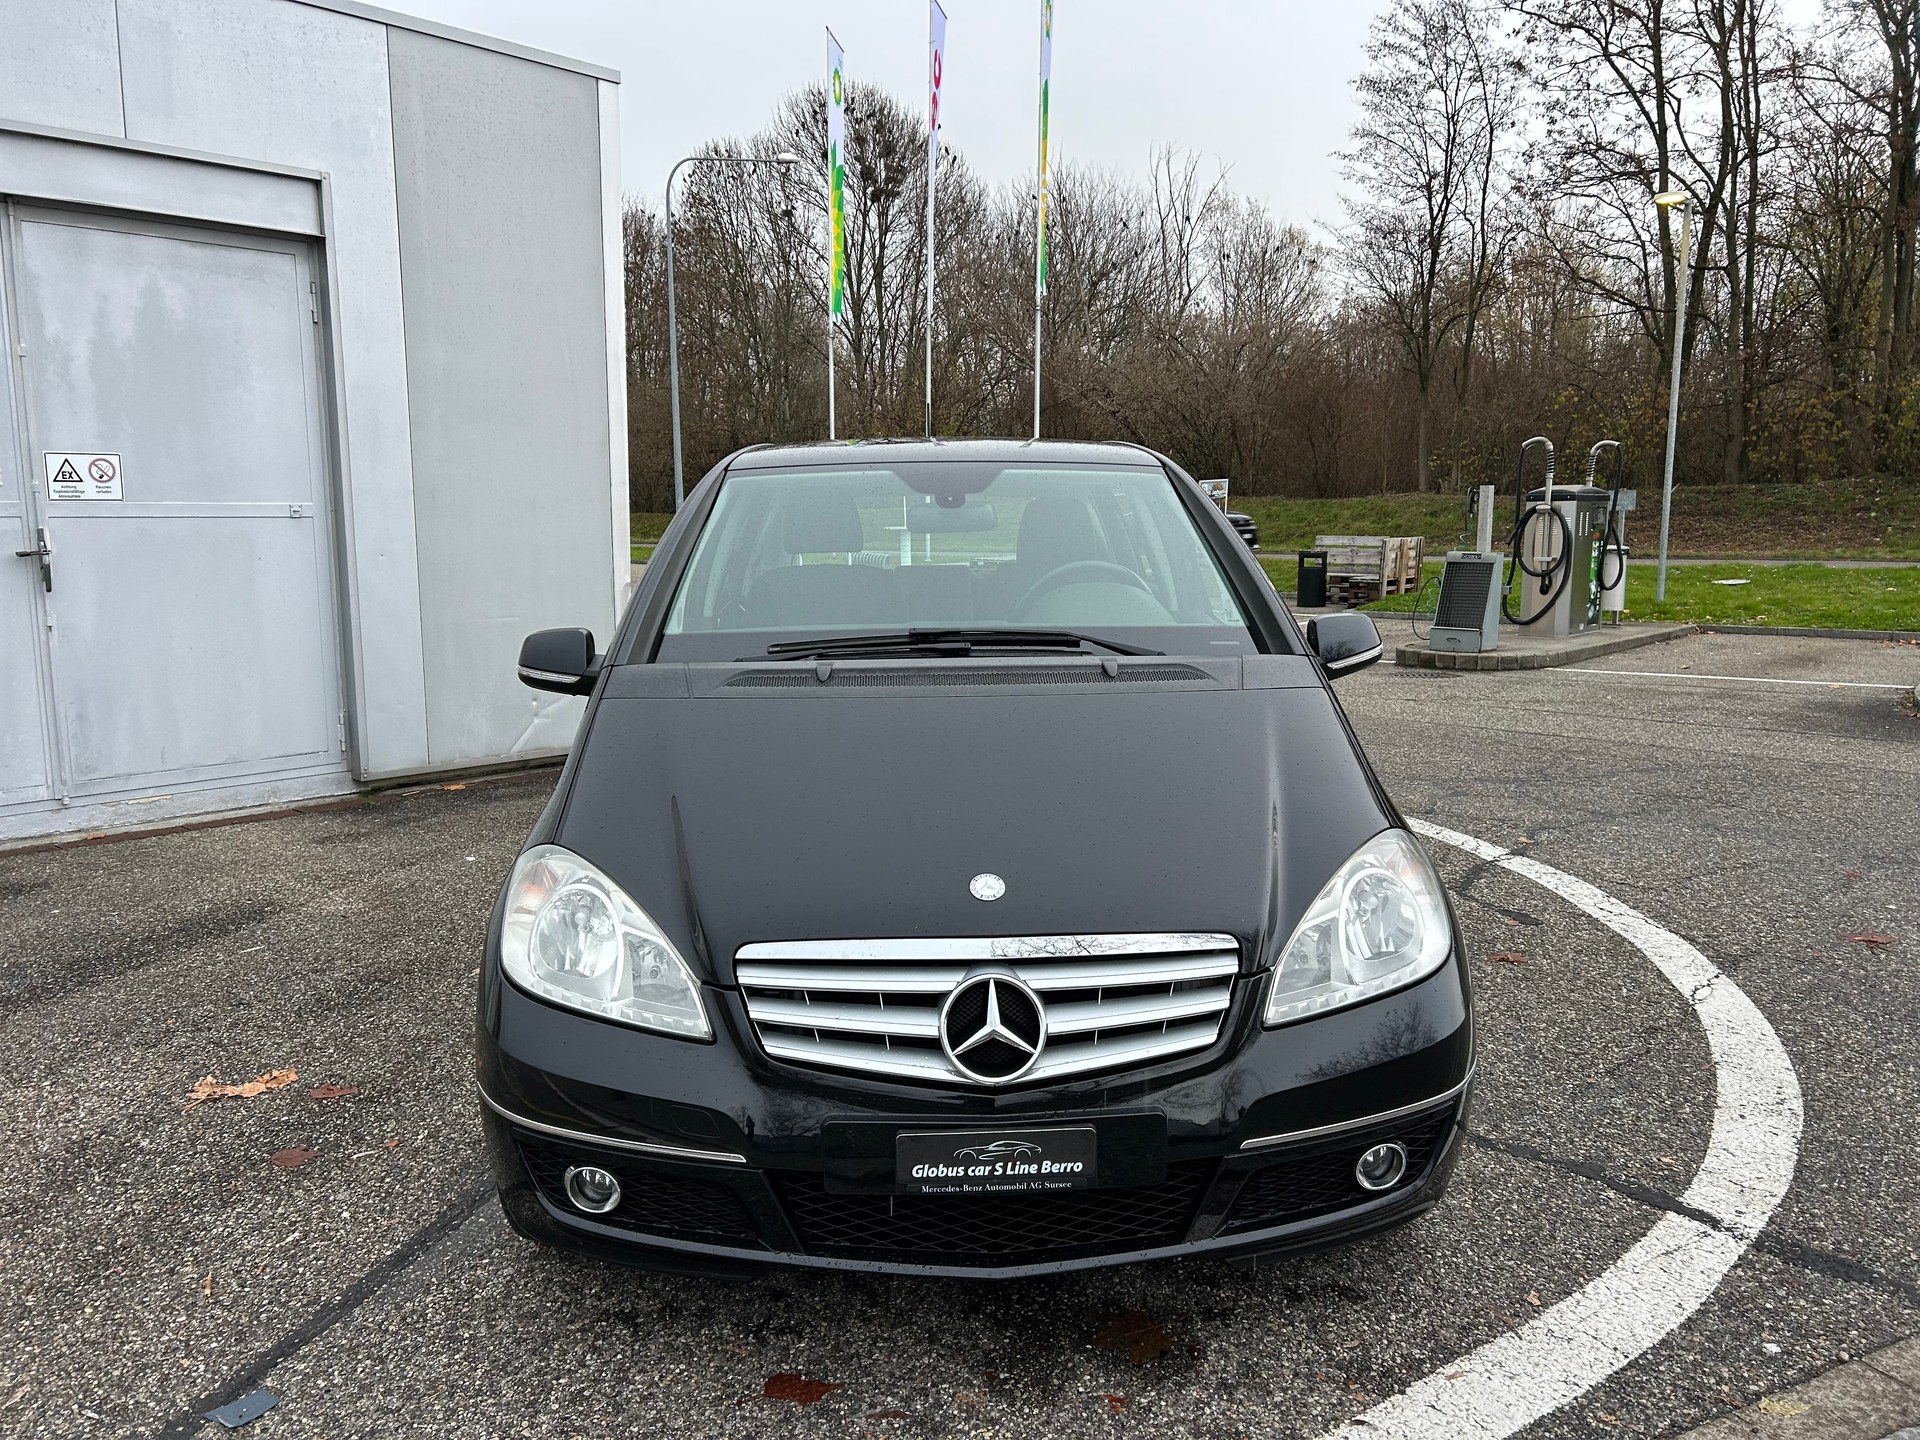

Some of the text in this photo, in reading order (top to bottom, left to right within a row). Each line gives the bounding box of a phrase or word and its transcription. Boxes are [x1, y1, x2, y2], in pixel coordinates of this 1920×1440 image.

[61, 471, 74, 480] EX
[912, 1160, 1083, 1178] Globus car S Line Berro
[921, 1180, 1072, 1193] Mercedes-Benz Automobil AG Sursee
